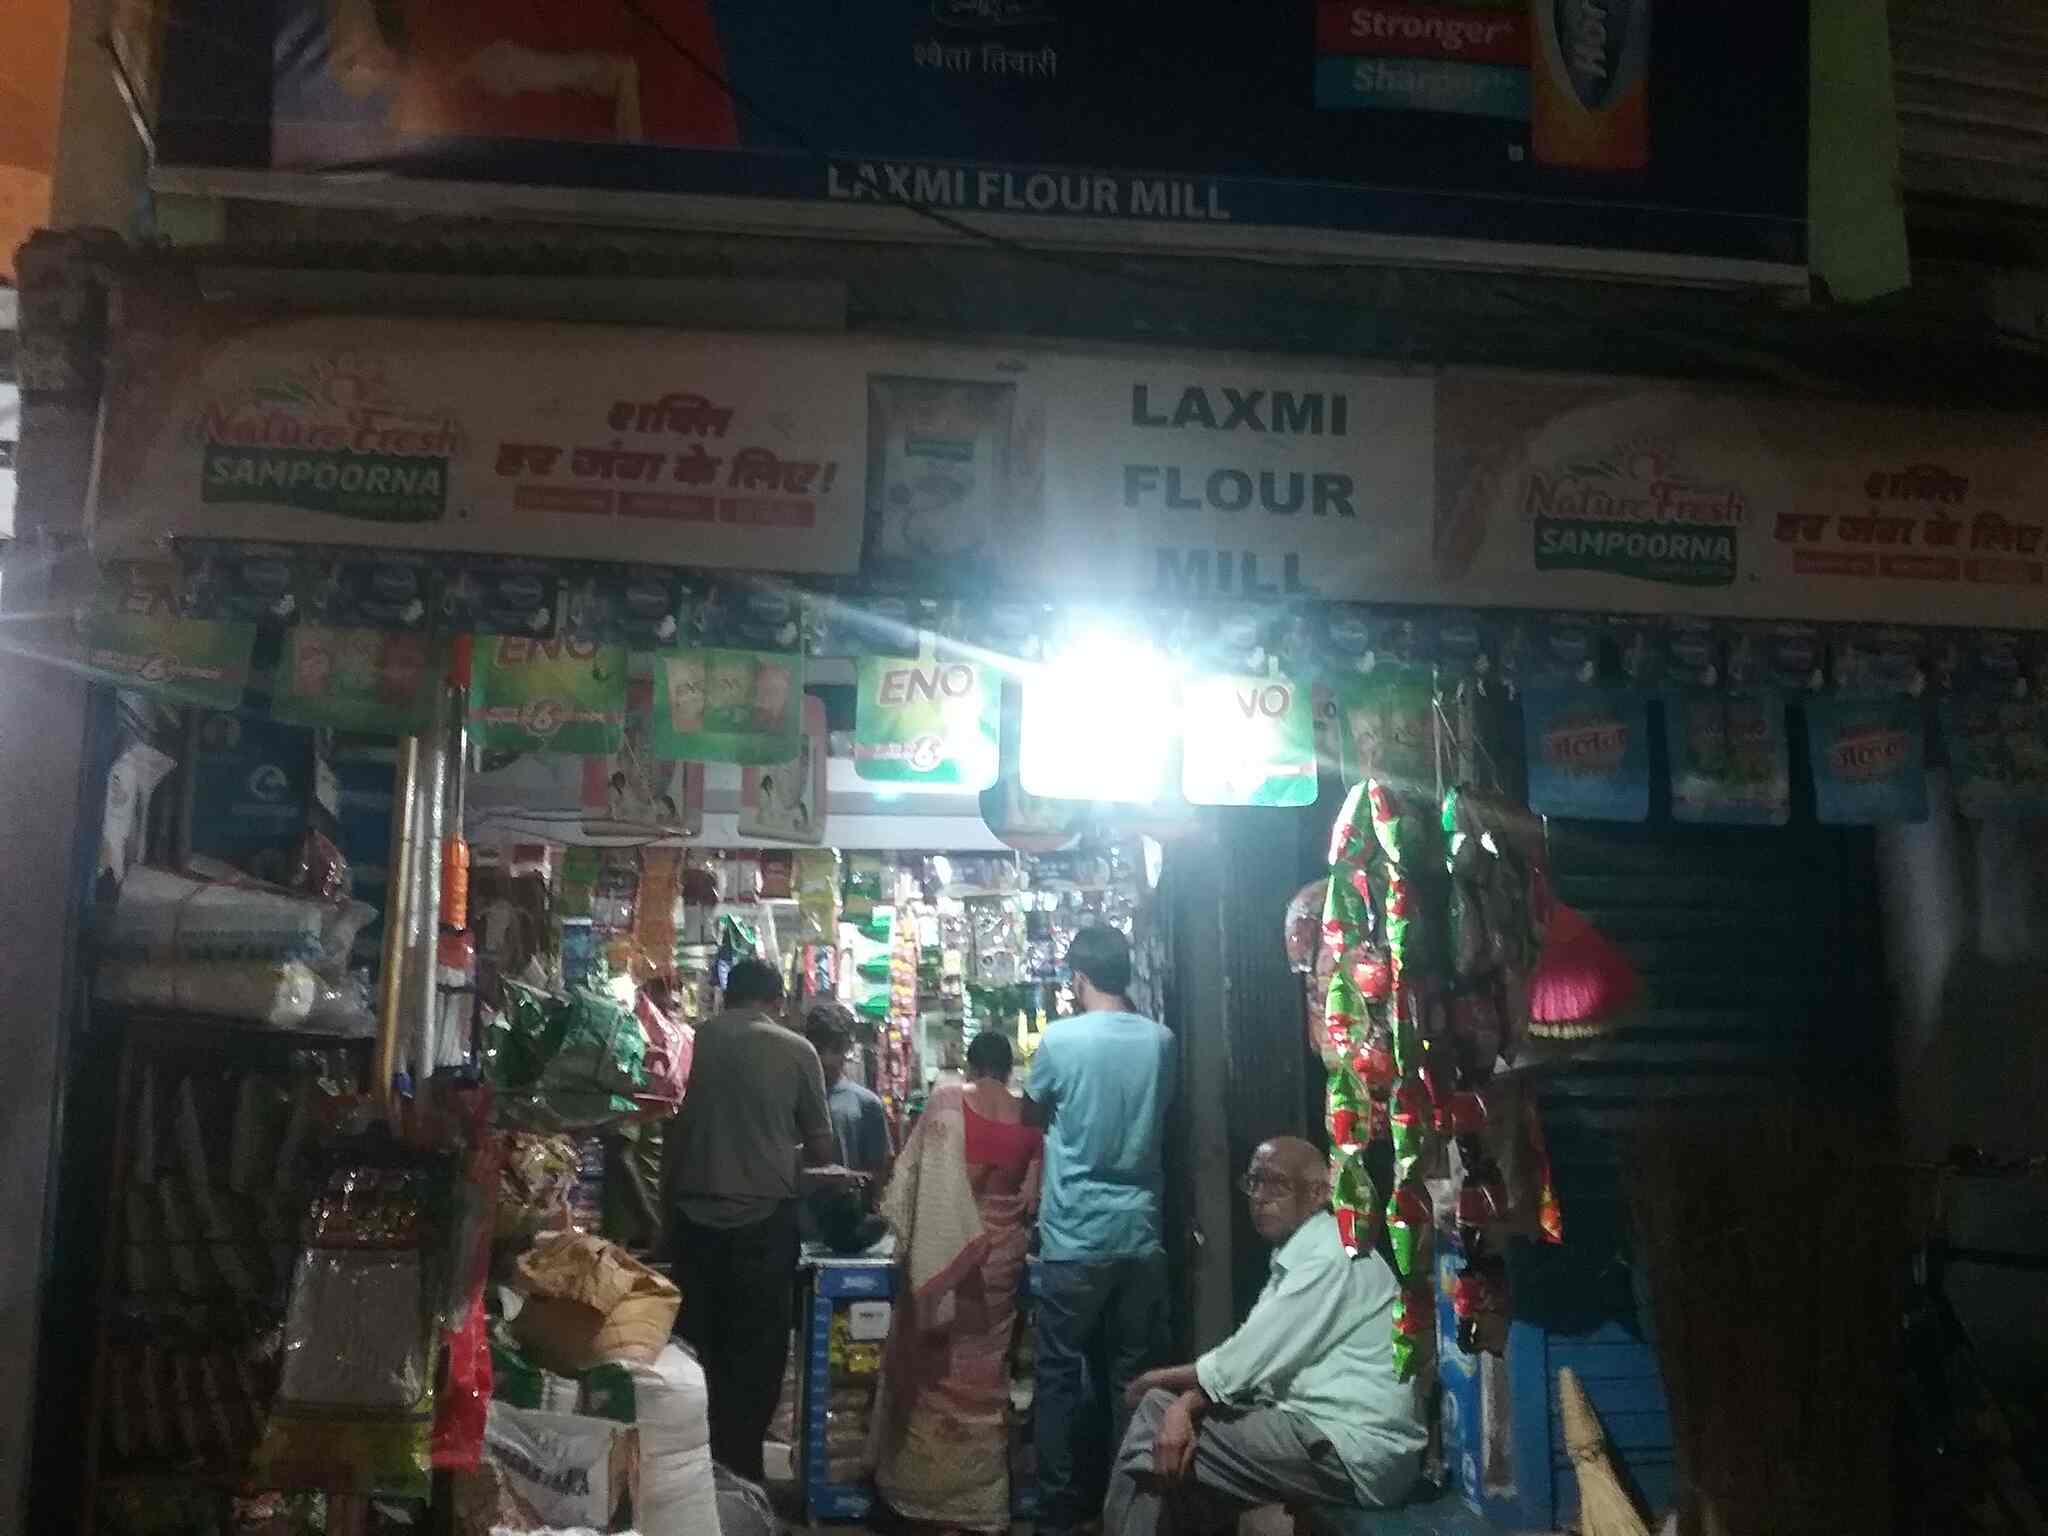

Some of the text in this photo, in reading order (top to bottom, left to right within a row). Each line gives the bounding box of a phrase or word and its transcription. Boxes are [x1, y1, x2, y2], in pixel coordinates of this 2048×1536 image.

[1351, 7, 1501, 50] Stronger
[827, 162, 1232, 220] LAXMI FLOUR MILL
[1132, 384, 1348, 437] LAXMI
[210, 455, 442, 496] SAMPOORNA
[1123, 465, 1356, 518] FLOUR
[1539, 527, 1733, 561] SAMPOORNA
[1154, 547, 1323, 597] MILL
[878, 664, 975, 706] ENO
